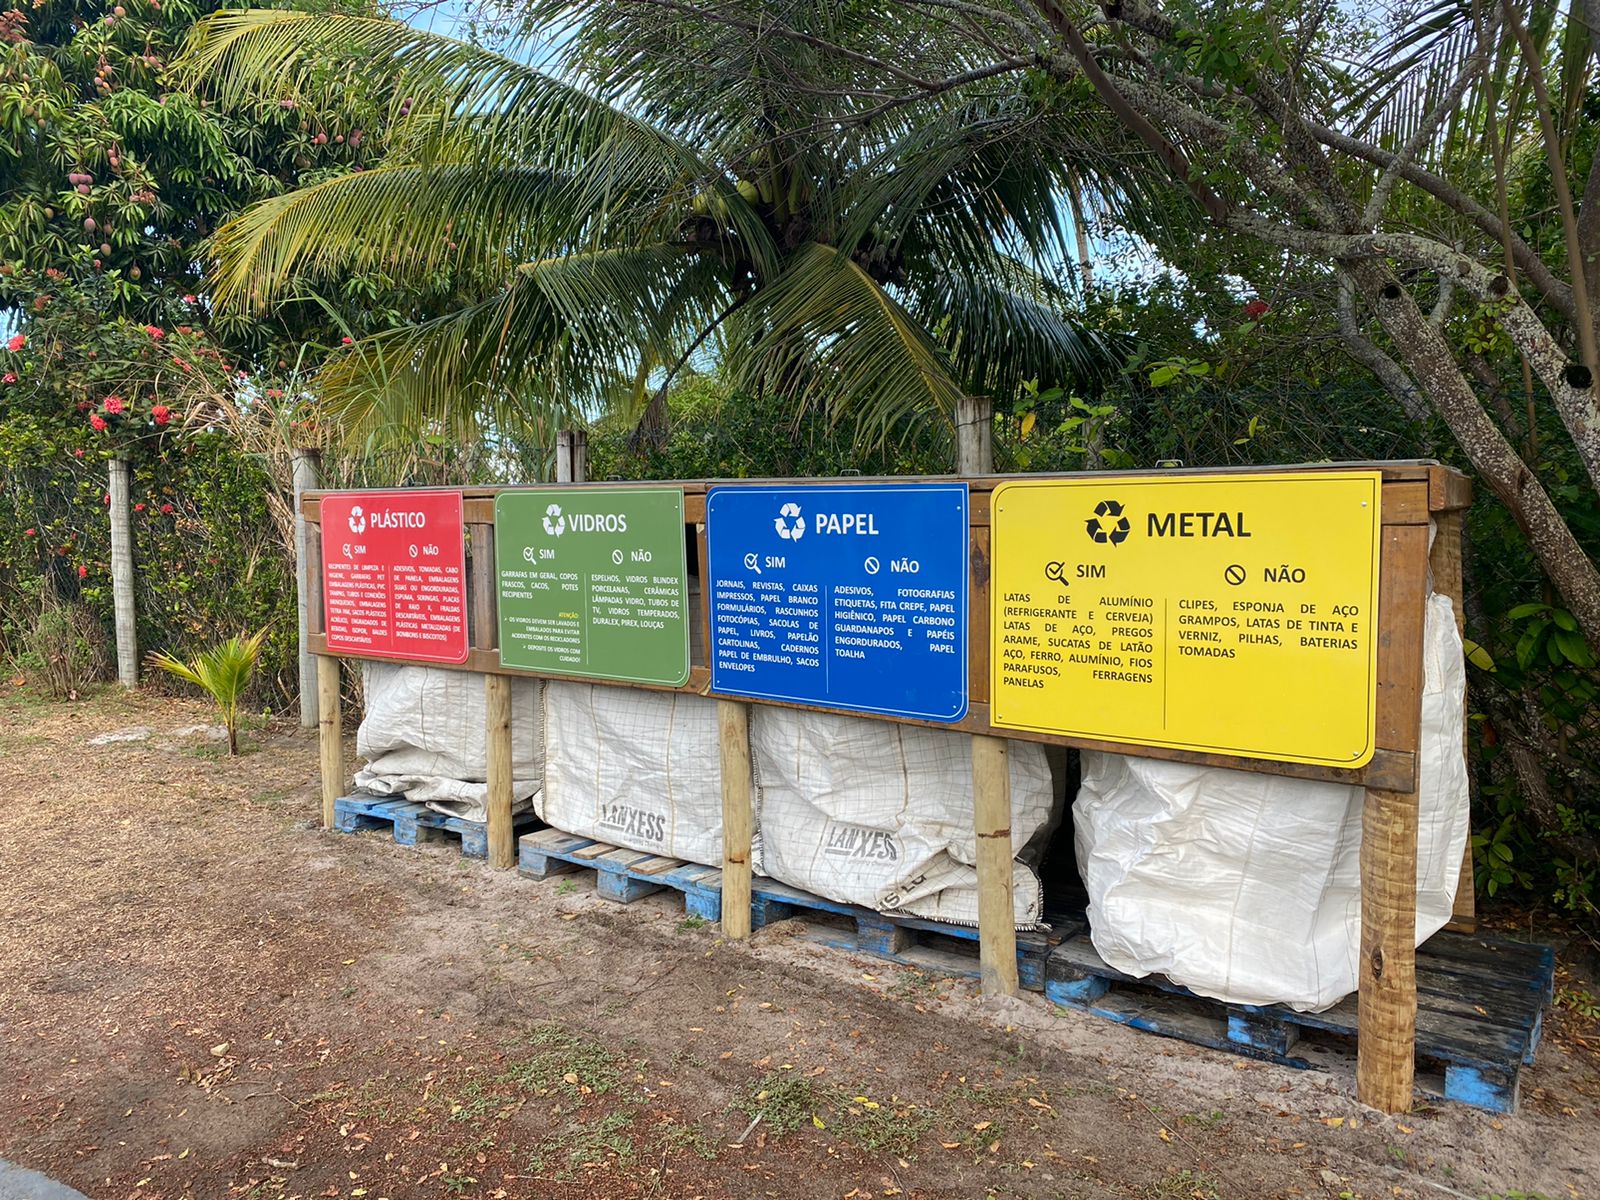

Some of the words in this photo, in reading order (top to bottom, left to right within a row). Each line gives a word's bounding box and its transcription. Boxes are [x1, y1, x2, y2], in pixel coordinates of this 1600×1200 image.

[371, 508, 425, 528] PLÁSTICO
[568, 514, 627, 532] VIDROS
[816, 513, 879, 535] PAPEL
[1147, 512, 1251, 537] METAL
[354, 546, 366, 554] SIM
[423, 544, 438, 555] NÃO
[539, 549, 554, 559] SIM
[631, 549, 651, 562] NÃO
[766, 557, 785, 568] SIM
[891, 558, 919, 573] NÃO
[592, 574, 620, 582] ESPELHOS,
[1076, 565, 1106, 578] SIM
[1264, 565, 1305, 583] NÃO
[592, 585, 630, 594] PORCELANAS,
[644, 586, 679, 595] CERÂMICAS
[716, 580, 745, 589] JORNAIS,
[753, 582, 785, 592] REVISTAS,
[793, 584, 818, 592] CAIXAS
[834, 586, 873, 596] ADESIVOS,
[898, 589, 955, 599] FOTOGRAFIAS
[717, 592, 755, 602] IMPRESSOS,
[761, 594, 781, 602] PAPEL
[789, 596, 818, 604] BRANCO
[1004, 594, 1030, 602] LATAS
[1058, 596, 1070, 604] DE
[1099, 596, 1153, 607] ALUMÍNIO
[718, 603, 766, 614] FORMULÁRIOS,
[776, 607, 818, 617] RASCUNHOS
[835, 599, 877, 609] ETIQUETAS,
[880, 601, 896, 609] FITA
[900, 602, 927, 612] CREPE,
[930, 604, 955, 613] PAPEL
[1179, 600, 1217, 611] CLIPES,
[1233, 602, 1284, 612] ESPONJA
[1301, 604, 1316, 614] DE
[1332, 606, 1359, 618] AÇO
[638, 609, 679, 619] TEMPERADOS,
[835, 610, 876, 622] HIGIÊNICO,
[883, 614, 906, 623] PAPEL
[913, 616, 955, 626] CARBONO
[1004, 607, 1076, 619] (REFRIGERANTE
[1089, 611, 1094, 620] E
[1106, 612, 1153, 624] CERVEJA)
[593, 618, 620, 626] DURALEX,
[622, 619, 639, 627] PIREX,
[641, 621, 664, 629] LOUÇAS
[718, 615, 760, 626] FOTOCÓPIAS,
[769, 619, 799, 628] SACOLAS
[1179, 615, 1240, 628] GRAMPOS,
[1247, 618, 1280, 628] LATAS
[1287, 620, 1302, 630] DE
[1309, 621, 1344, 632] TINTA
[1352, 623, 1358, 632] E
[718, 627, 739, 636] PAPEL,
[751, 629, 775, 639] LIVROS,
[788, 632, 818, 642] PAPELÃO
[835, 624, 894, 635] GUARDANAPOS
[927, 629, 954, 640] PAPÉIS
[1004, 621, 1030, 630] LATAS
[1045, 623, 1057, 632] DE
[1072, 625, 1096, 636] AÇO,
[1112, 627, 1153, 638] PREGOS
[718, 638, 760, 650] CARTOLINAS,
[781, 644, 819, 654] CADERNOS
[835, 636, 902, 650] ENGORDURADOS,
[930, 644, 955, 653] PAPEL
[1003, 635, 1040, 647] ARAME,
[1048, 638, 1090, 648] SUCATAS
[1100, 641, 1111, 650] DE
[1121, 642, 1153, 653] LATÃO
[1179, 631, 1222, 643] VERNIZ,
[1239, 634, 1282, 646] PILHAS,
[1300, 637, 1357, 649] BATERIAS
[719, 650, 738, 658] PAPEL
[753, 653, 793, 665] EMBRULHO,
[797, 657, 819, 667] SACOS
[835, 649, 865, 659] TOALHA
[1003, 650, 1025, 660] AÇO,
[1031, 651, 1063, 662] FERRO,
[1069, 654, 1123, 667] ALUMÍNIO,
[1130, 658, 1152, 668] FIOS
[1179, 646, 1235, 658] TOMADAS
[719, 661, 755, 672] ENVELOPES
[1004, 663, 1060, 677] PARAFUSOS,
[1093, 670, 1152, 683] FERRAGENS
[1004, 677, 1044, 688] PANELAS
